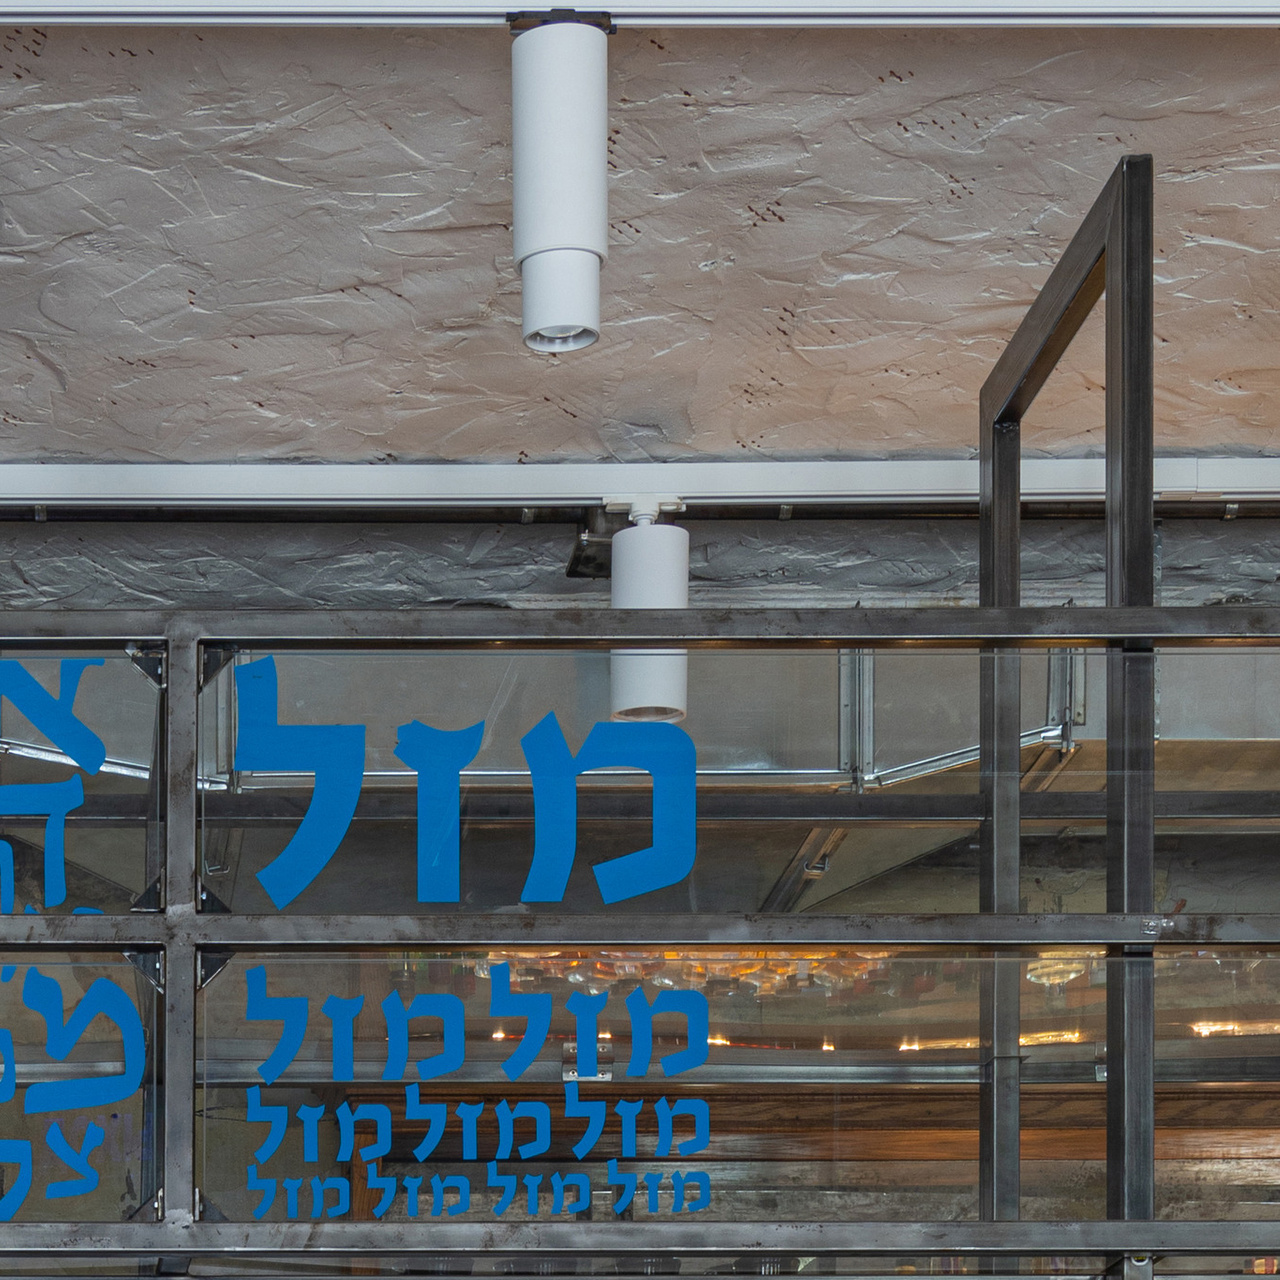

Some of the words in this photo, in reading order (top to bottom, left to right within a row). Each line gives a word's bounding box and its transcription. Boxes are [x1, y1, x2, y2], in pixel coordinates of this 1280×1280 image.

[234, 655, 696, 910] מזל
[246, 966, 464, 1085] מזל
[490, 962, 708, 1081] מזל
